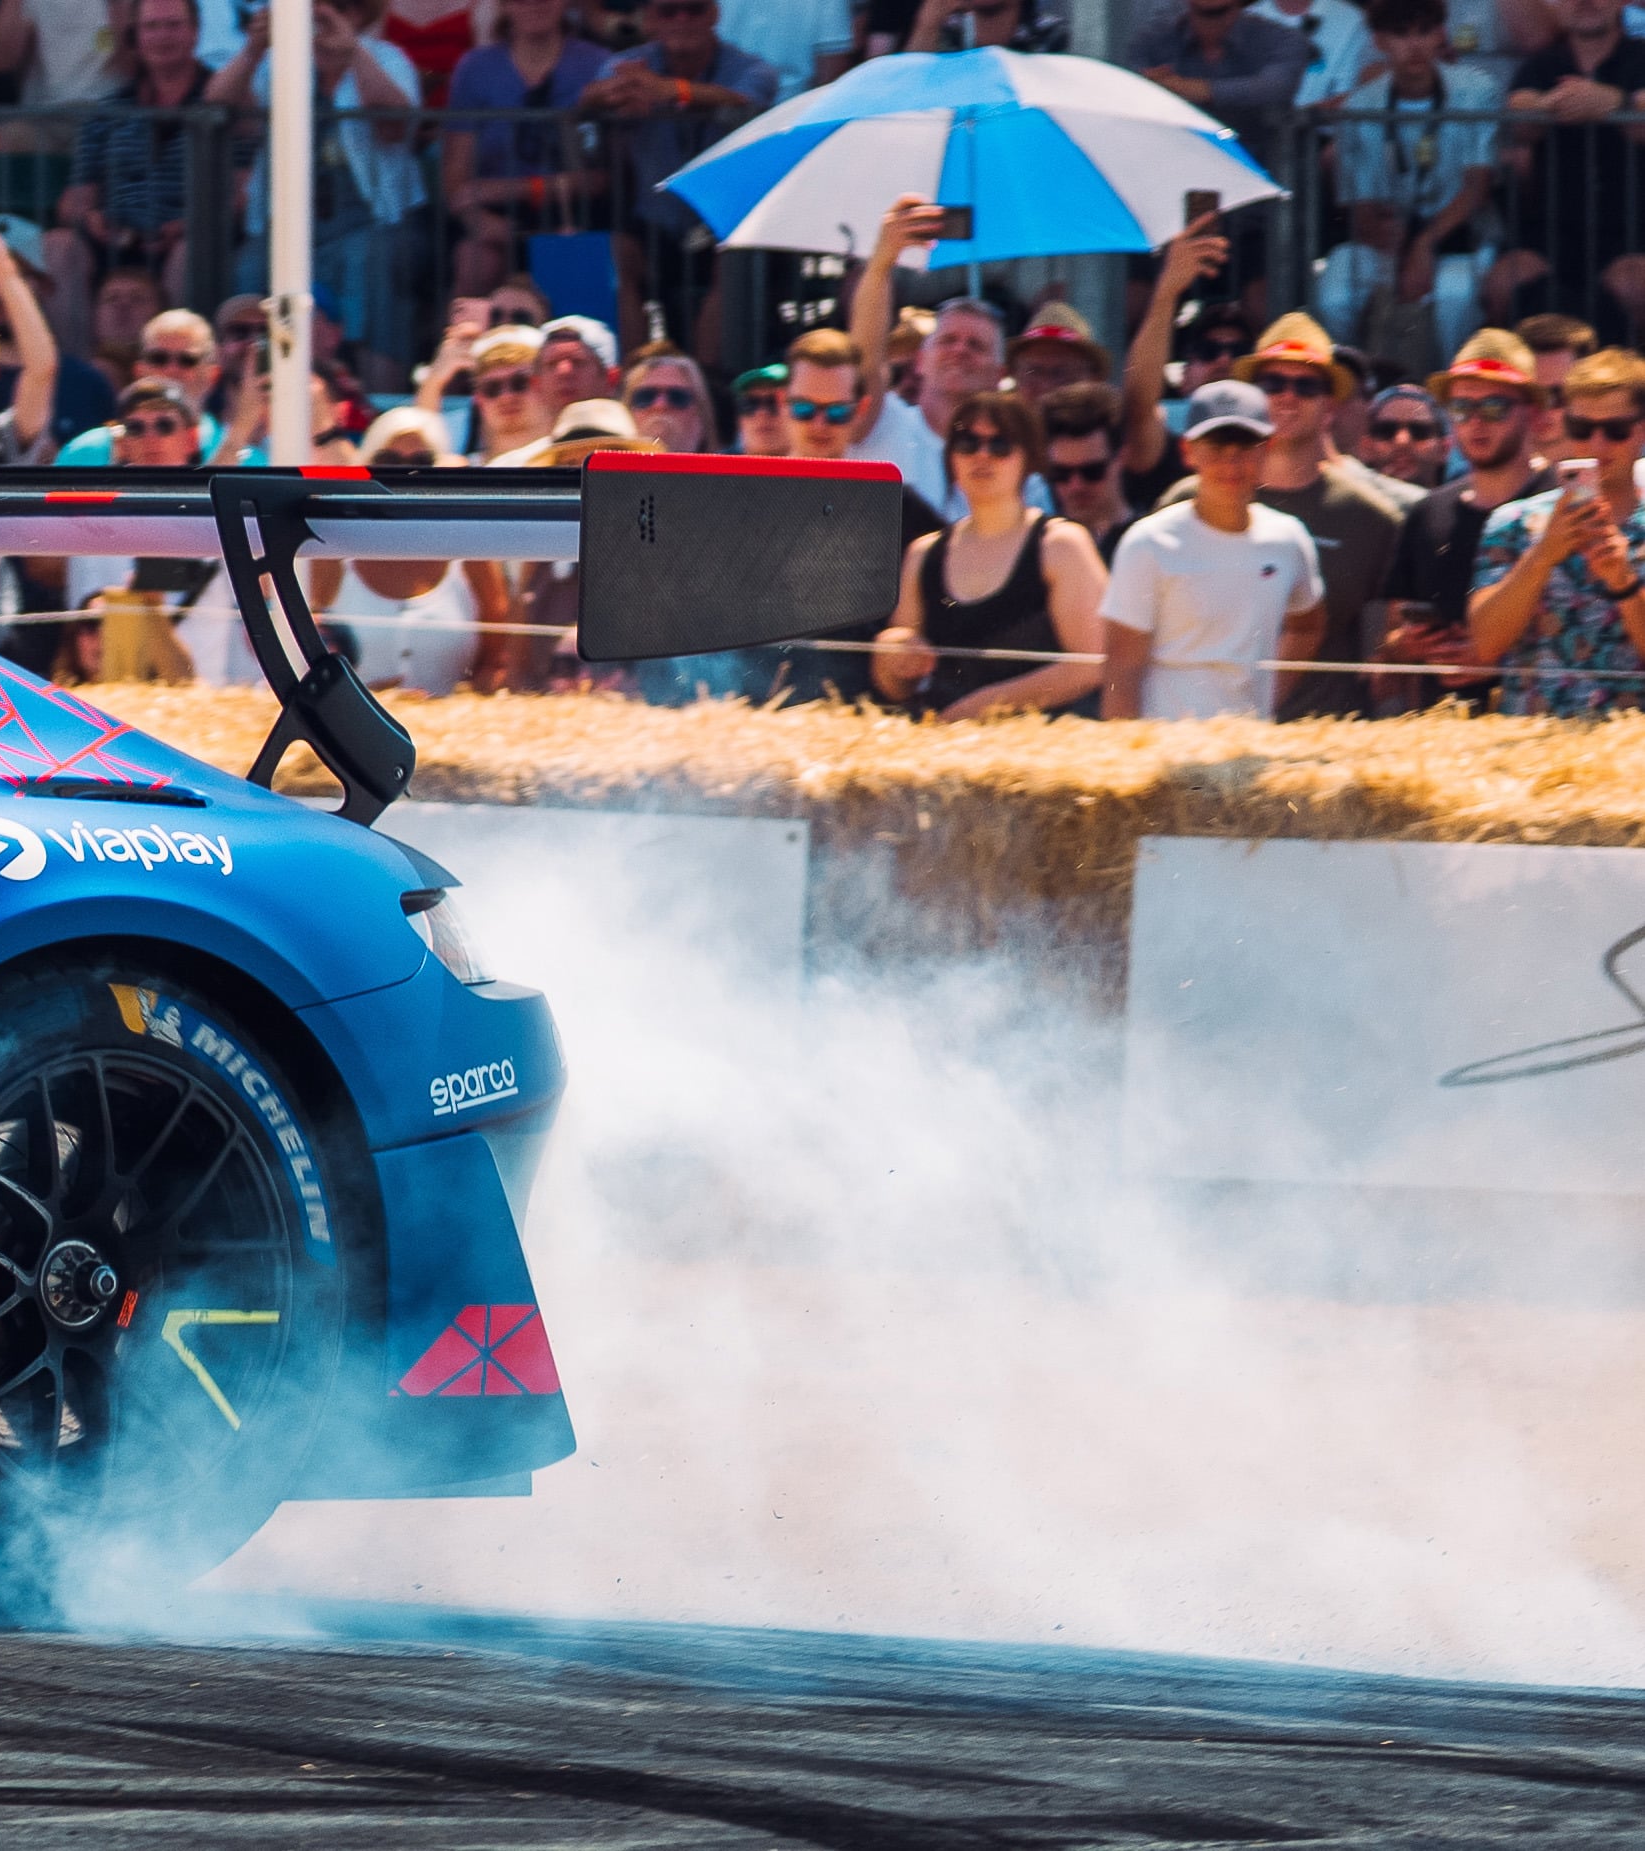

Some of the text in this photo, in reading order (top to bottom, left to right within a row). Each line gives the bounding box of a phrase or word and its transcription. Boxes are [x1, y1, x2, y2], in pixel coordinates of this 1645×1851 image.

[45, 820, 234, 876] viaplay
[430, 1058, 516, 1114] sparco
[190, 1023, 331, 1243] MICHELIN
